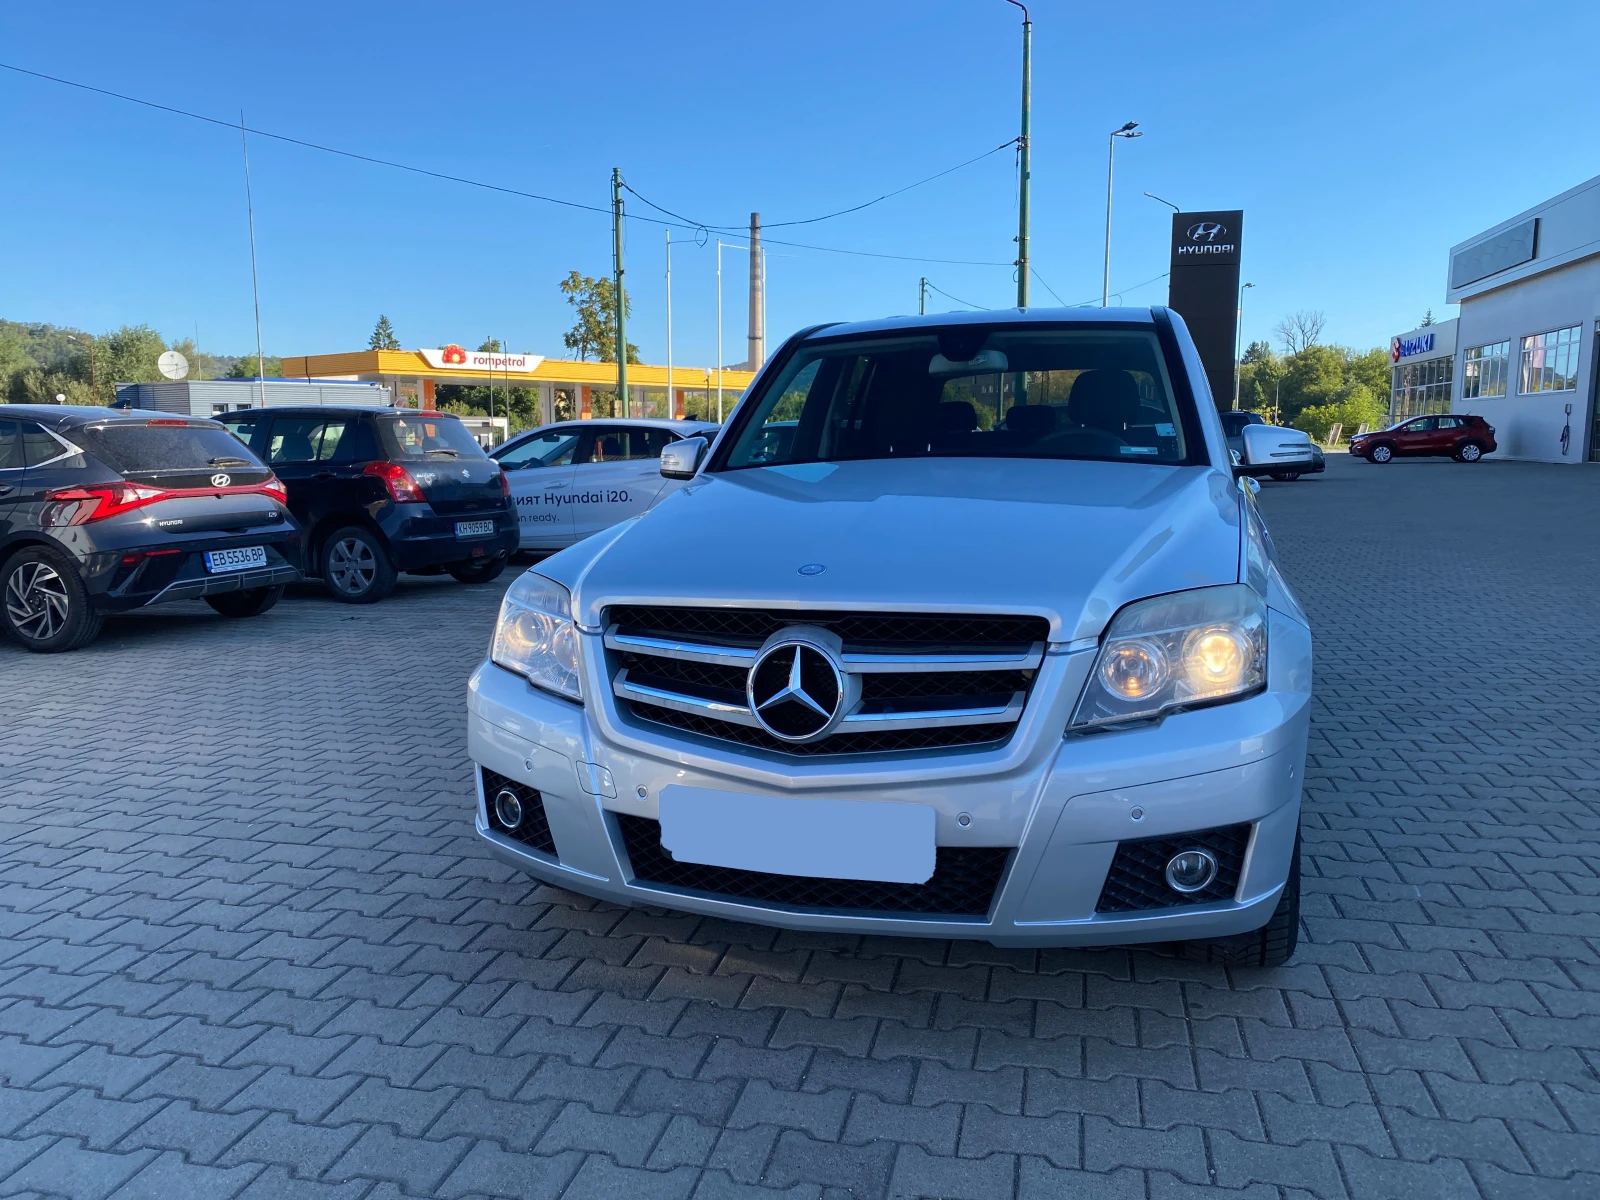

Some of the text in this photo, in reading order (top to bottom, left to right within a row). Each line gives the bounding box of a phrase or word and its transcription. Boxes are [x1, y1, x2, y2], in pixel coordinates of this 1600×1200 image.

[1178, 244, 1234, 255] HYUNDAI
[1400, 333, 1434, 357] SUZUKI
[473, 356, 526, 369] rompetrol
[513, 490, 633, 507] ият Hyundai i20.
[159, 519, 184, 527] HYUNDAI
[529, 512, 560, 523] ready.
[226, 549, 251, 564] 5536
